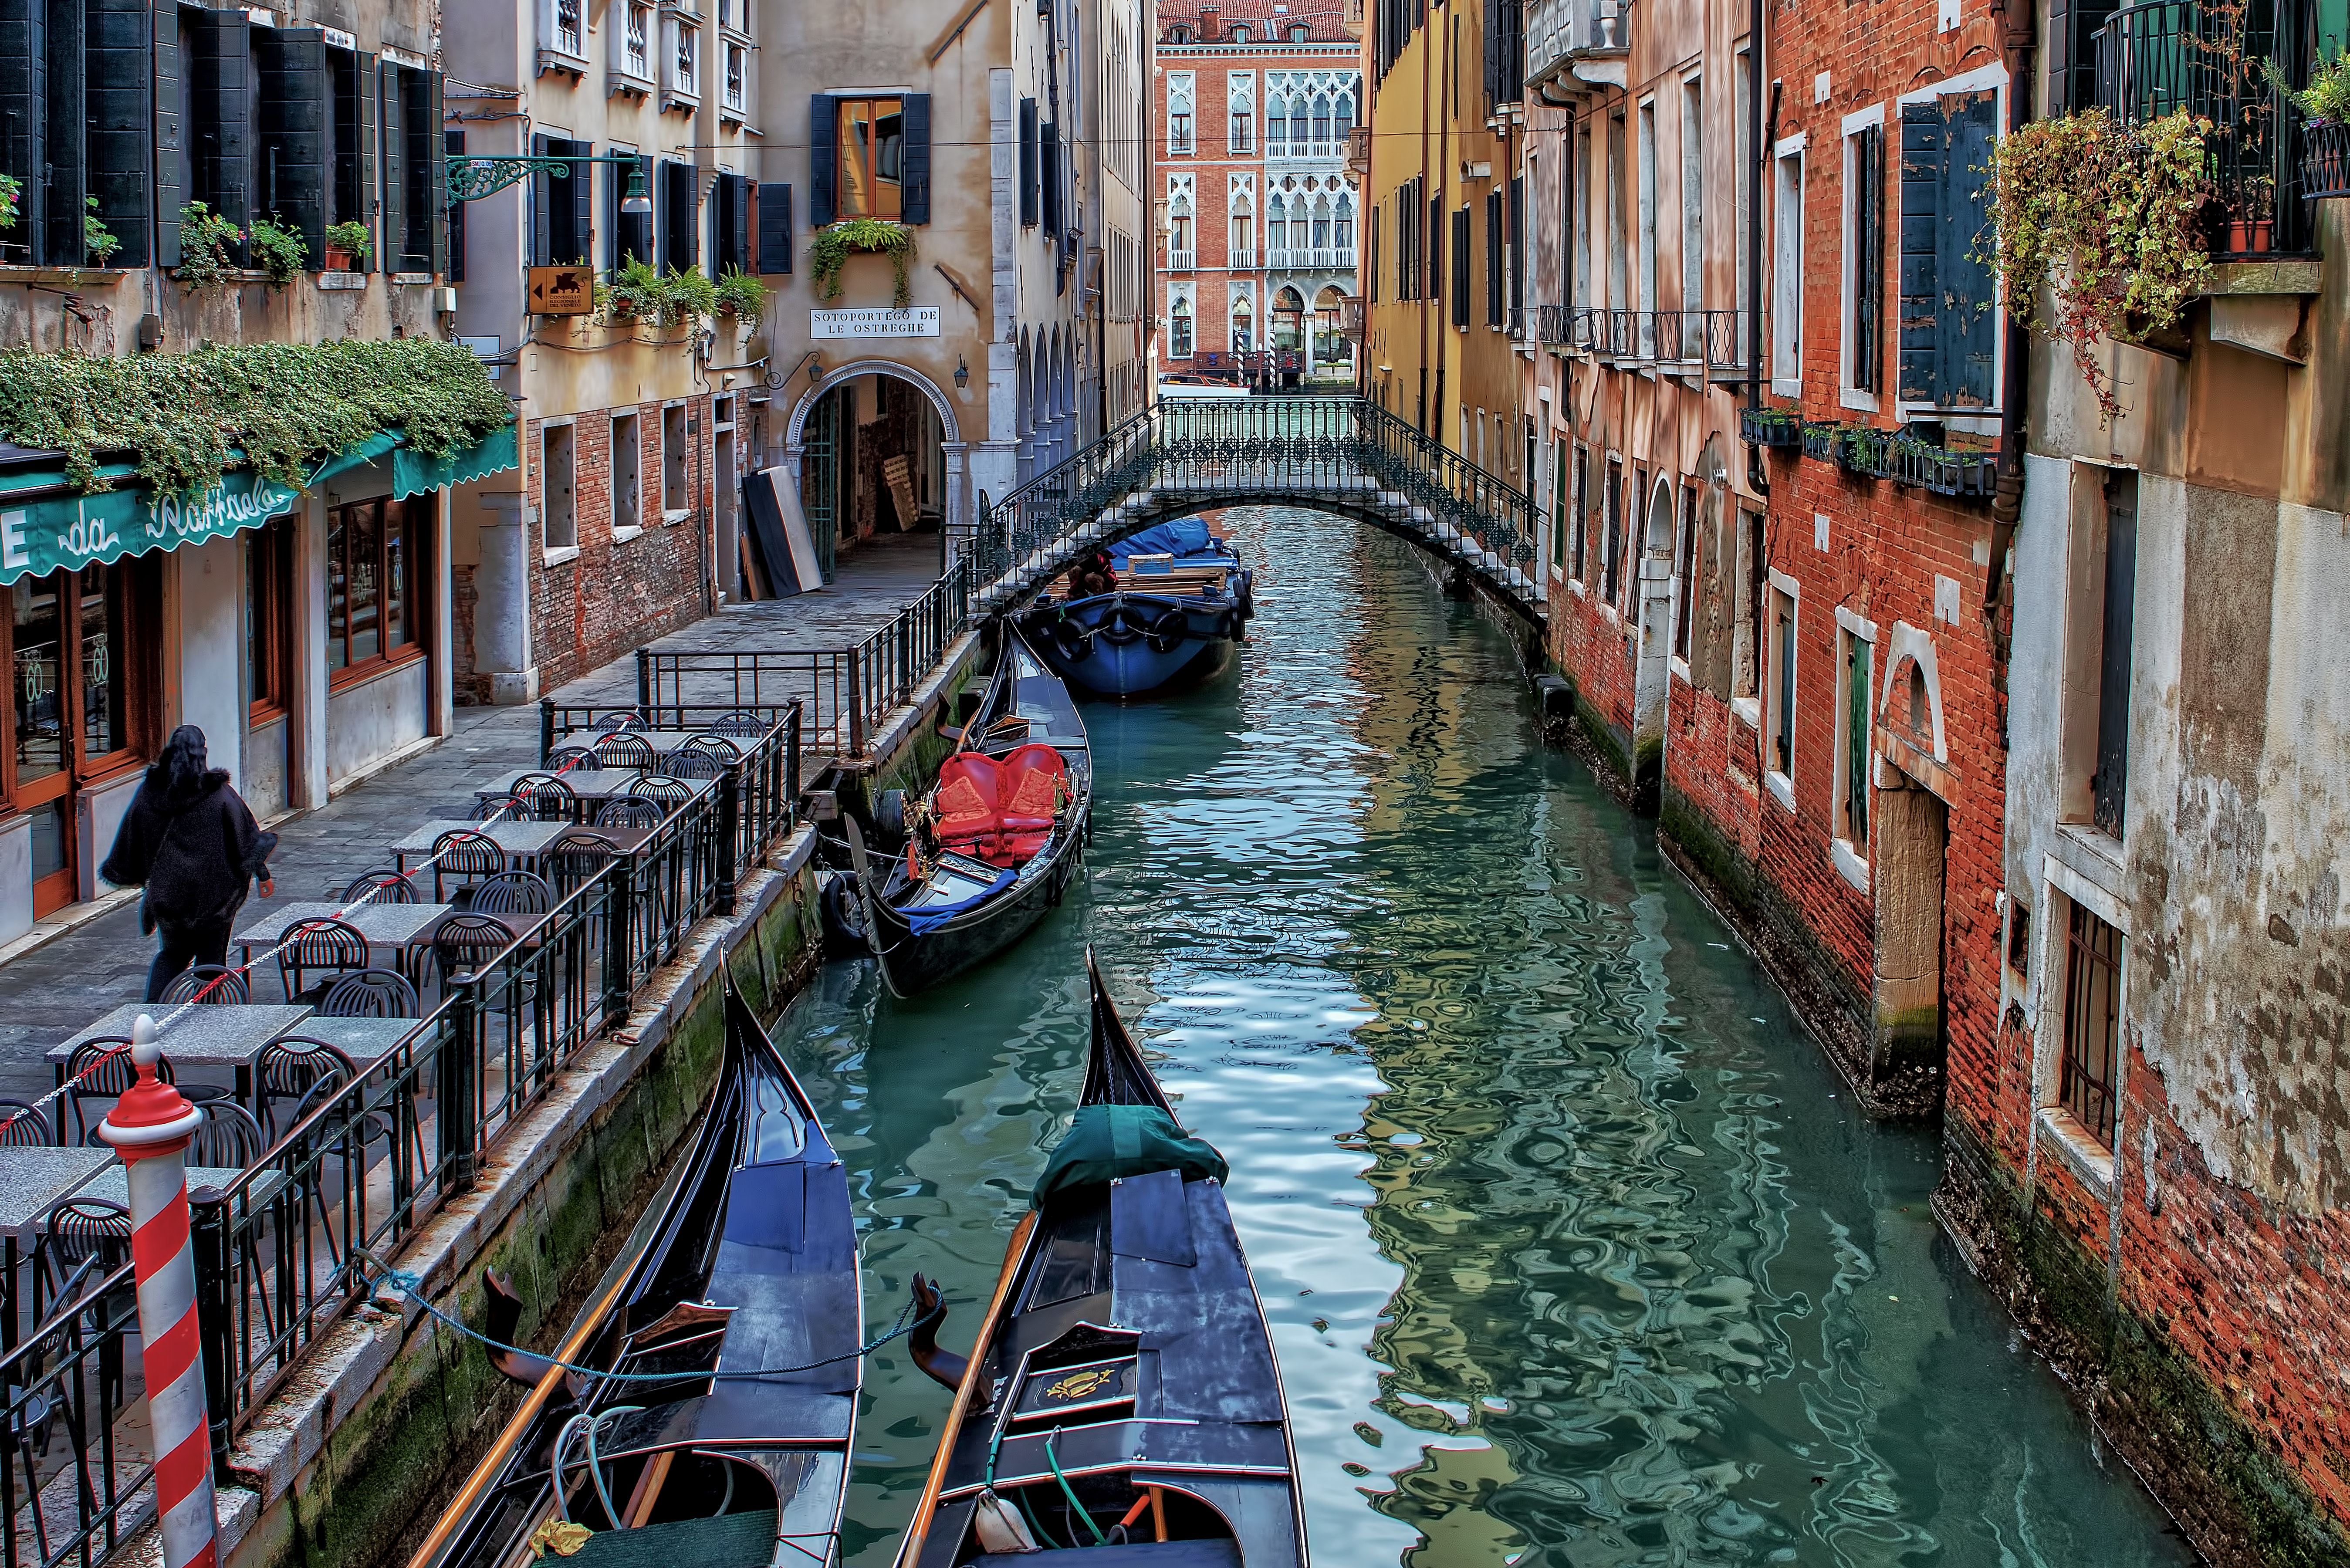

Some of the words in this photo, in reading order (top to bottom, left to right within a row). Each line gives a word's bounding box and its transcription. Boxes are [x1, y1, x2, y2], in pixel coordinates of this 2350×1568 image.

[815, 311, 910, 322] SOTOPORTEGO
[920, 311, 936, 320] DE
[828, 325, 844, 334] LE
[854, 323, 924, 333] OSTREGHE
[57, 500, 121, 556] da
